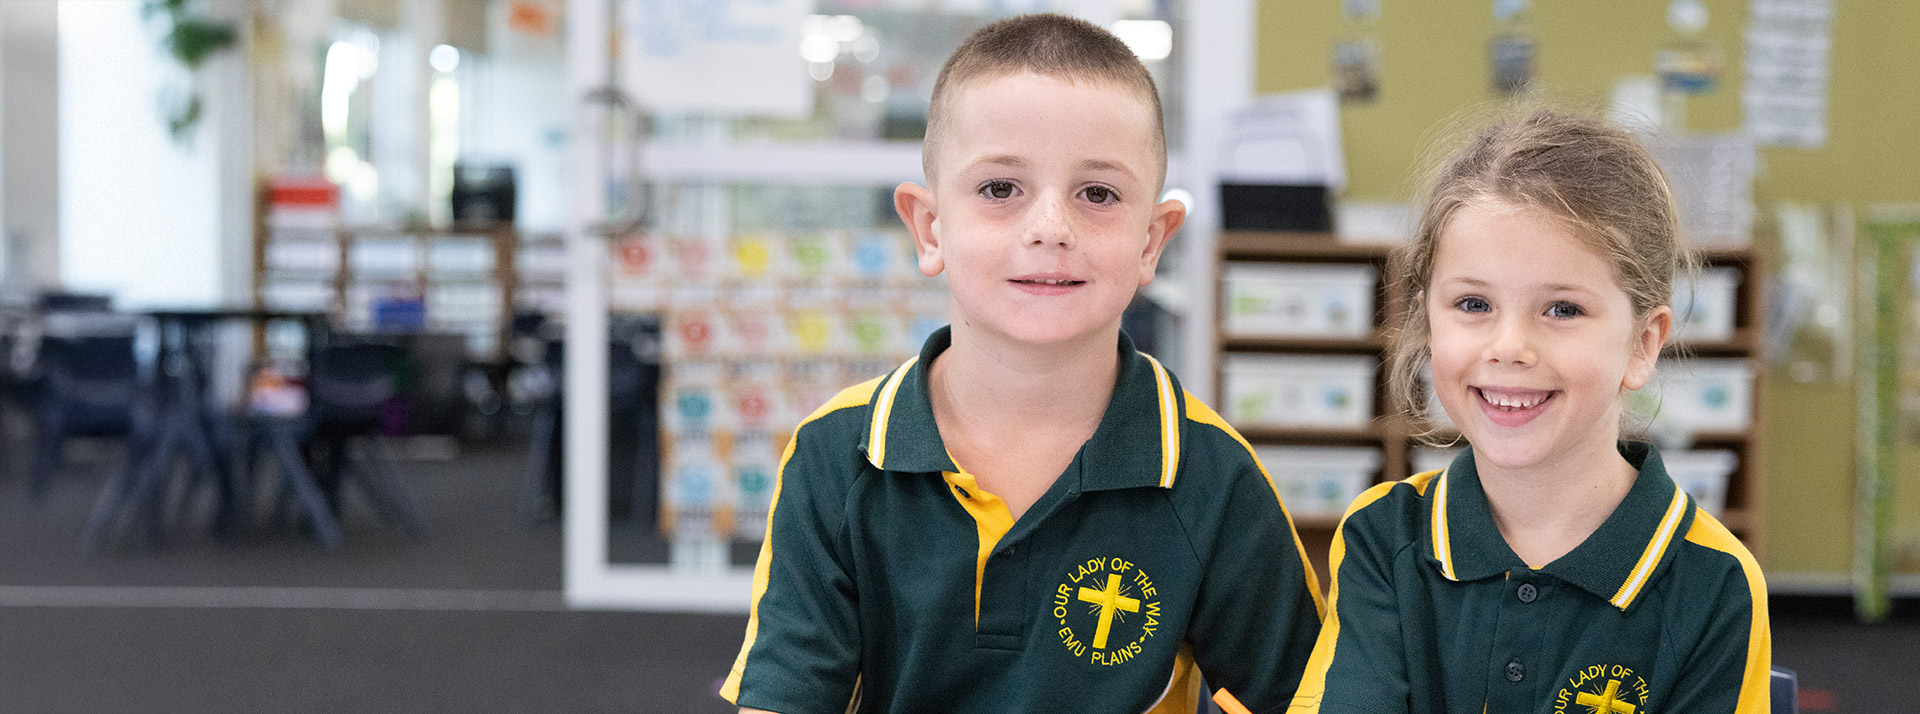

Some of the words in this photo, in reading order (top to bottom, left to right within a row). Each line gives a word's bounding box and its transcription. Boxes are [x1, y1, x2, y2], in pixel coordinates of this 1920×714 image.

[1068, 556, 1106, 583] LADY
[1111, 557, 1134, 573] OF
[1053, 583, 1073, 618] OUR
[1133, 569, 1157, 600] THE
[1142, 601, 1161, 637] WAY
[1058, 626, 1086, 657] EMU
[1091, 641, 1142, 666] PLAINS
[1569, 663, 1607, 688] LADY
[1611, 664, 1634, 679] OF
[1632, 675, 1649, 706] THE
